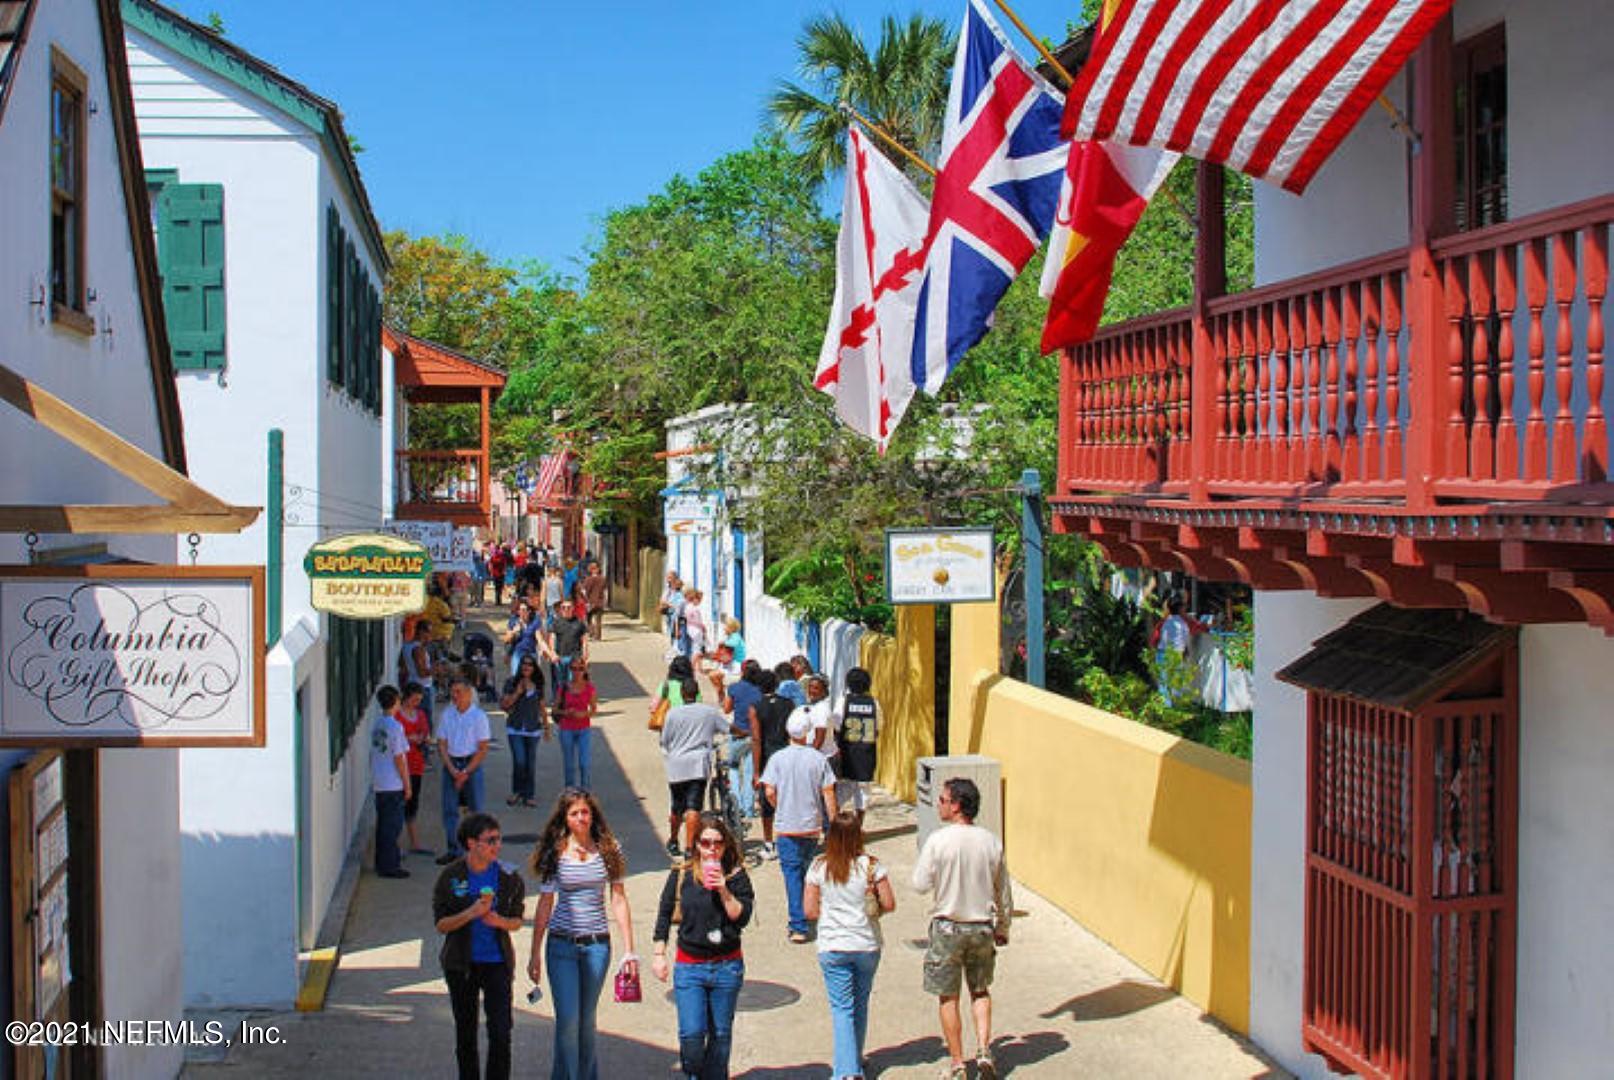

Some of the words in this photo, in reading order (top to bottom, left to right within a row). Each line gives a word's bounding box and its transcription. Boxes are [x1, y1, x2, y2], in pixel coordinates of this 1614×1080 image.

[326, 583, 412, 597] BOUTIQUE
[44, 613, 210, 651] Columbia
[59, 657, 117, 698] Gift
[123, 656, 191, 698] Shop
